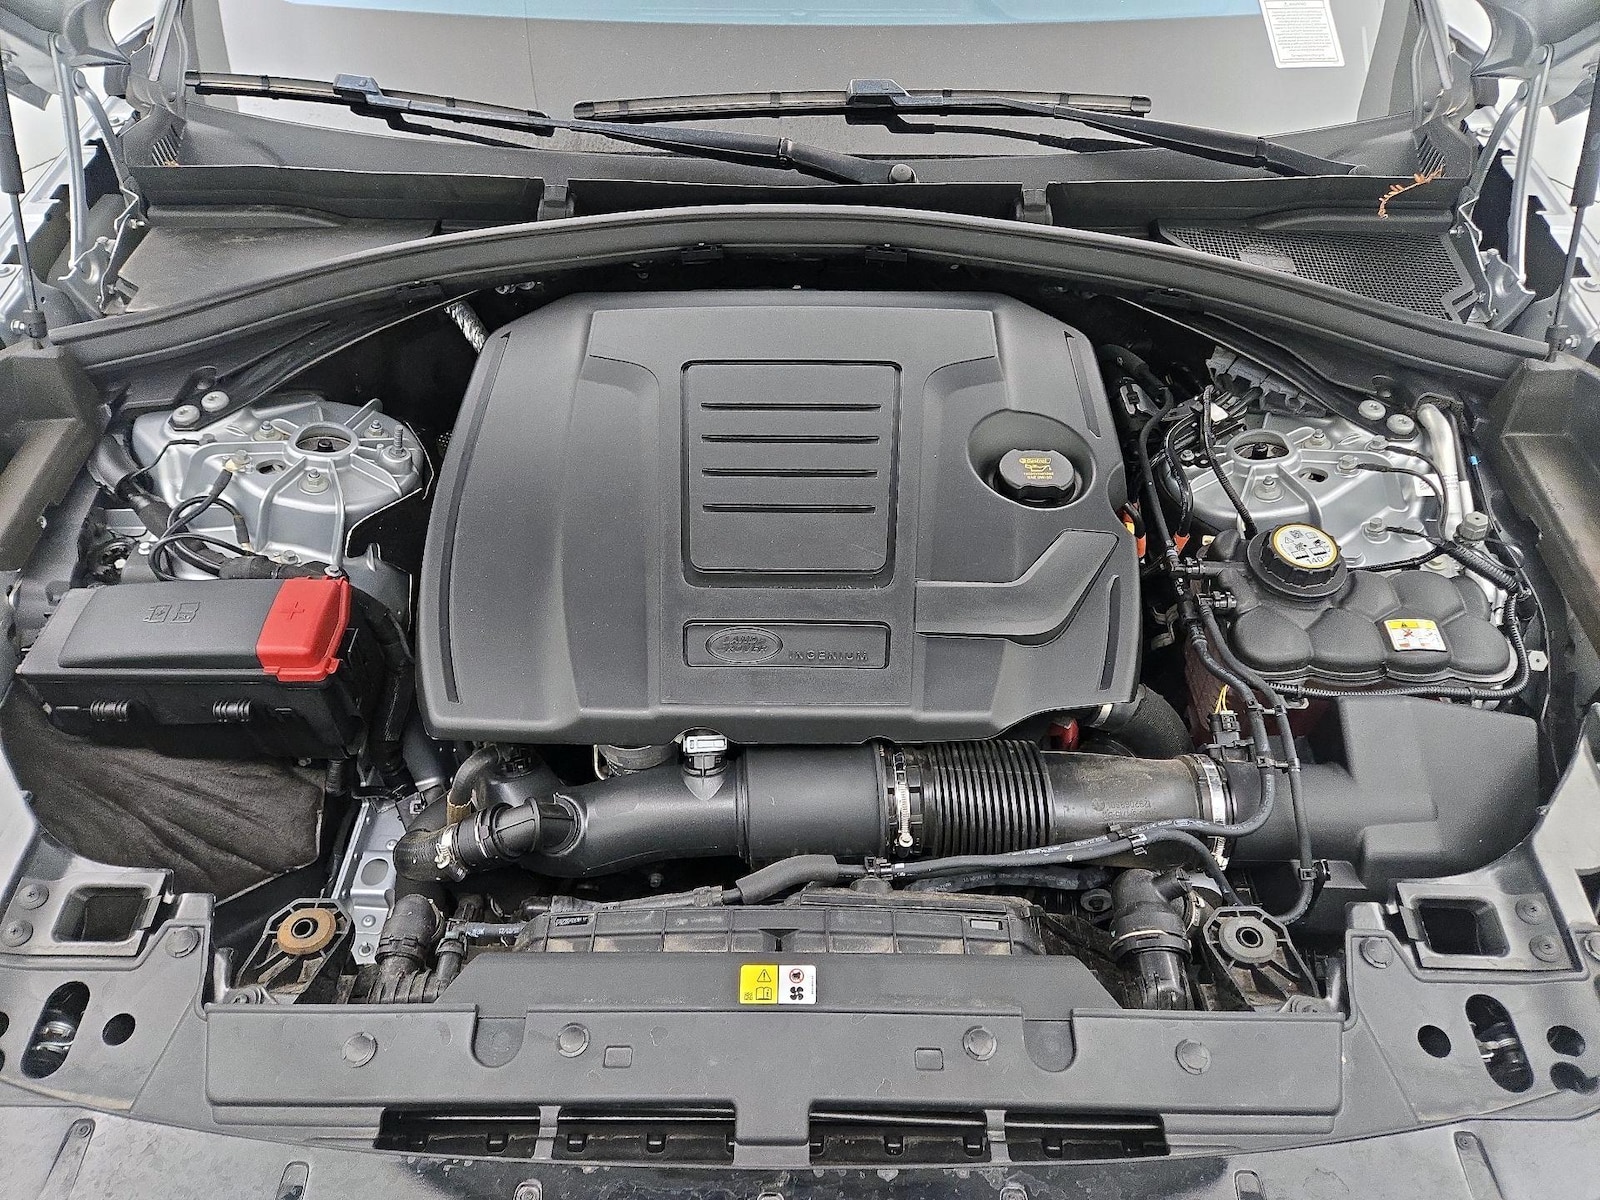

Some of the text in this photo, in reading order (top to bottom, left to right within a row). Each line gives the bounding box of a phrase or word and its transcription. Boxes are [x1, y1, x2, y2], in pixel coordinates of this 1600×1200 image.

[722, 635, 760, 645] LAND
[725, 644, 768, 653] ROVER
[788, 650, 869, 661] INGENIUM
